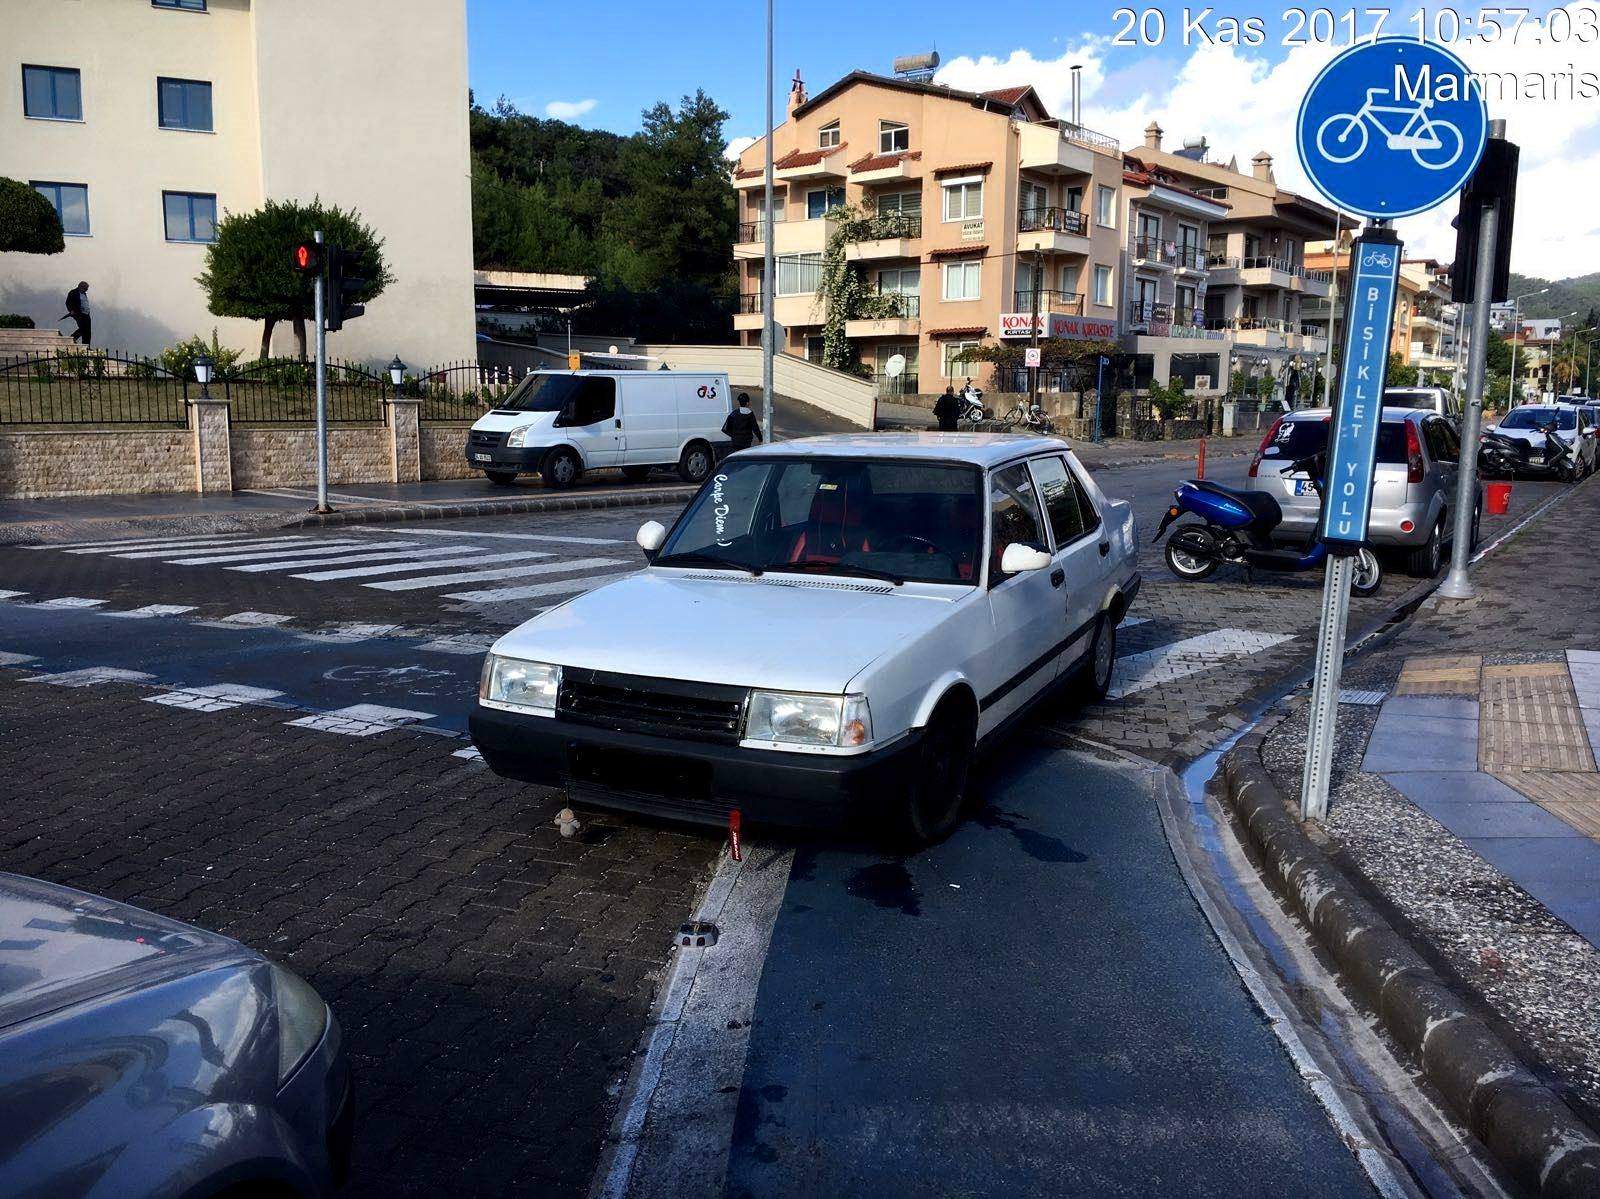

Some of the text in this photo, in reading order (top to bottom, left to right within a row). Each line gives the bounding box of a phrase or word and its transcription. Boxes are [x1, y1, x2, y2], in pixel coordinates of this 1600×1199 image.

[1338, 286, 1380, 535] BİSİKLET YOLU
[709, 474, 728, 504] Carpe
[1302, 481, 1314, 492] 45
[714, 504, 730, 535] Diem
